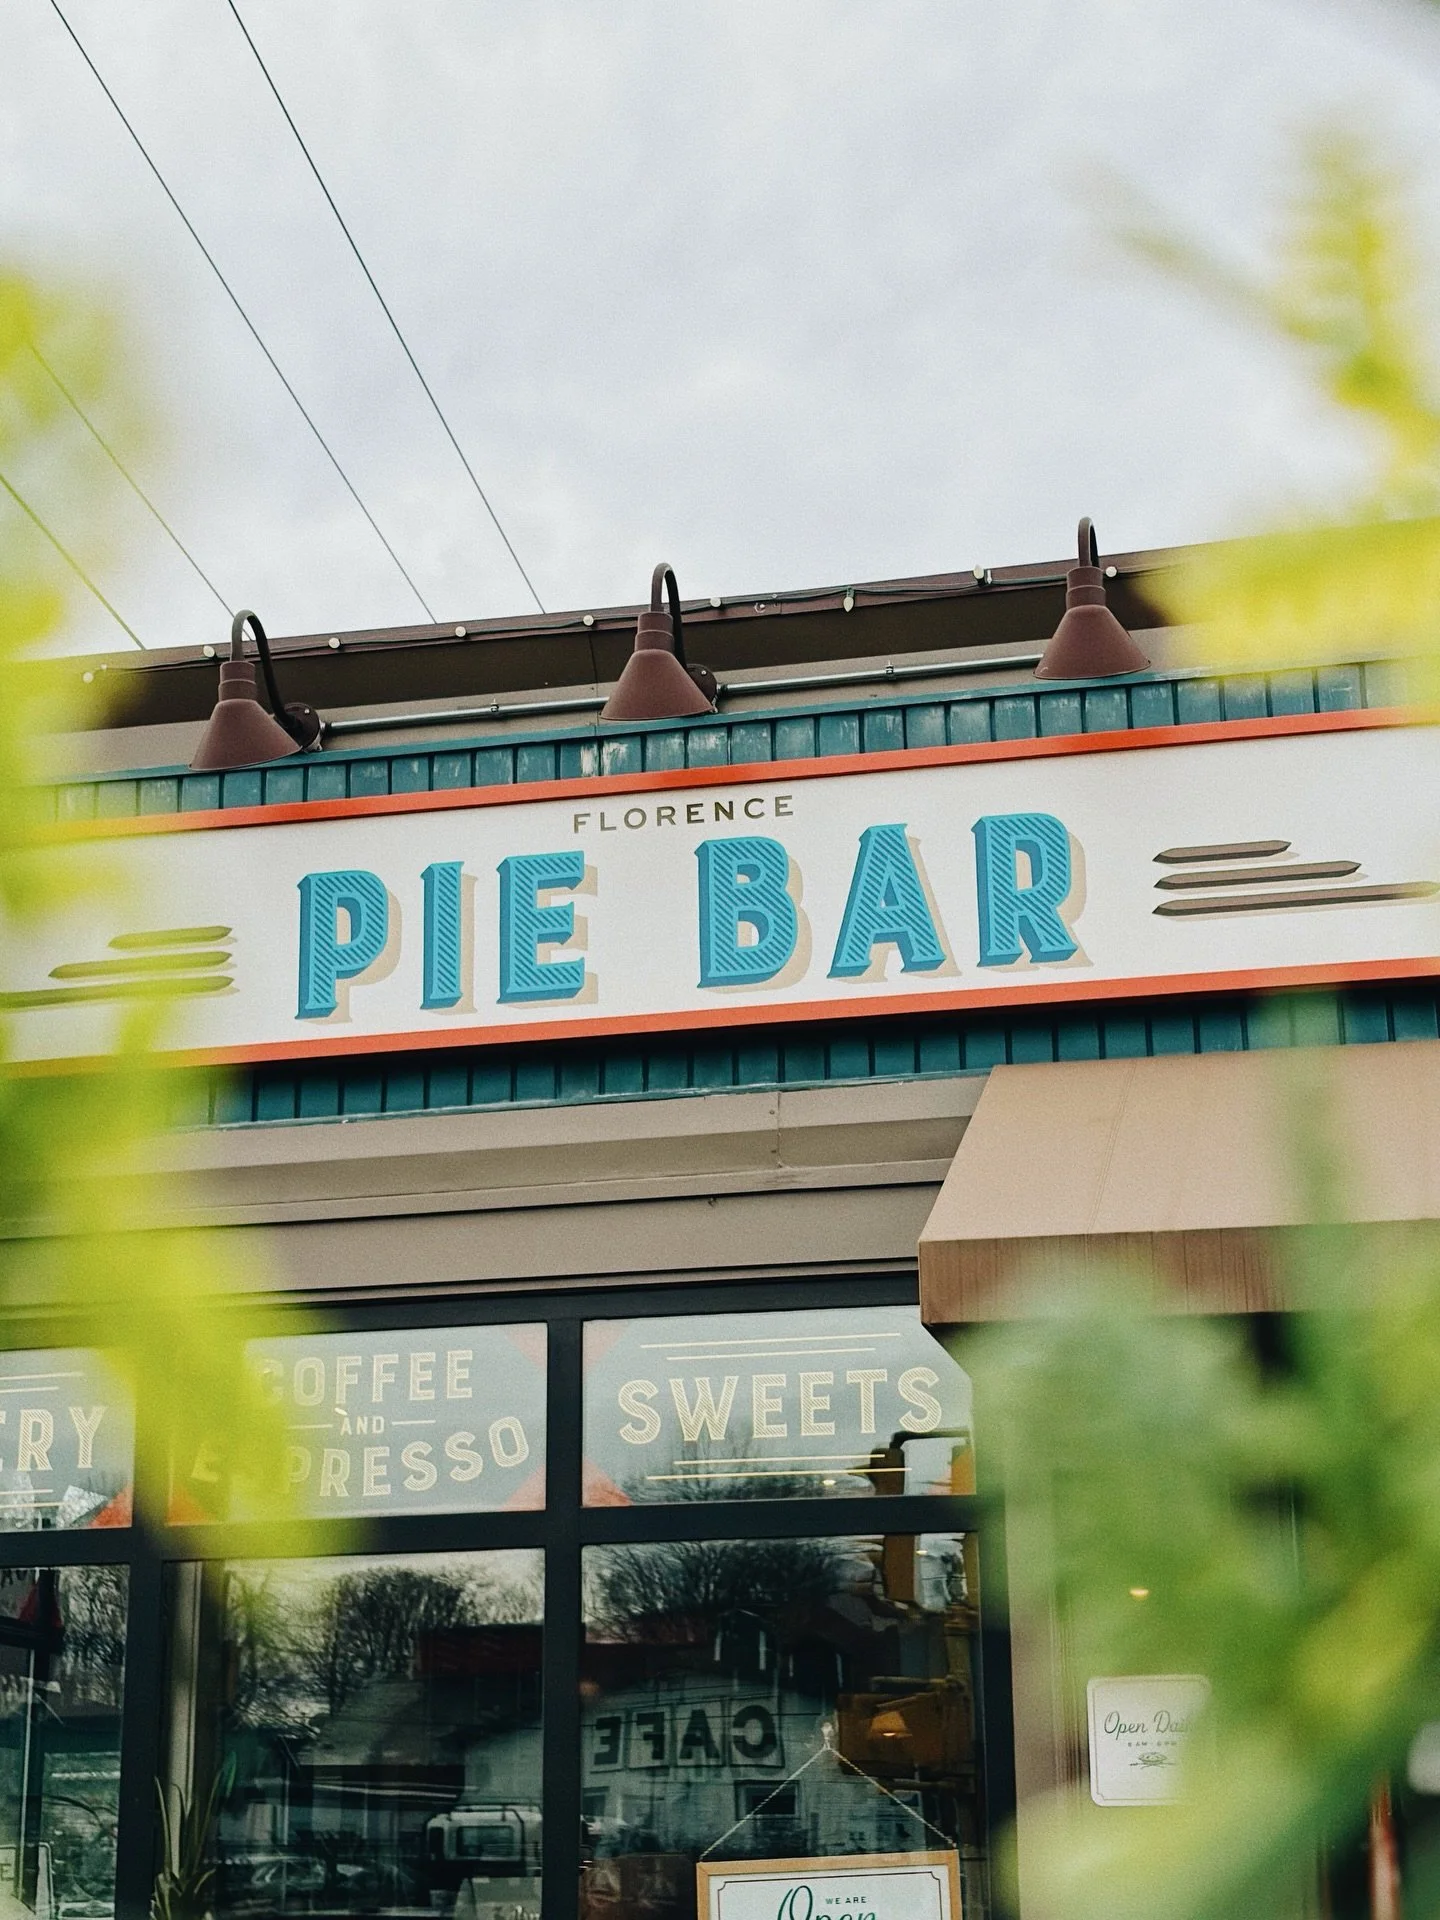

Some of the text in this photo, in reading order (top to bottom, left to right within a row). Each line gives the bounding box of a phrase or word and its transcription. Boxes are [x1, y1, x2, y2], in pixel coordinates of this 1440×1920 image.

[574, 795, 795, 834] FLORENCE
[296, 812, 1084, 1021] PIE BAR
[340, 1415, 386, 1436] AND
[617, 1366, 943, 1444] SWEETS
[0, 1406, 109, 1472] RY
[190, 1416, 530, 1498] EPRESSO
[1104, 1709, 1191, 1741] Open Dai
[845, 1896, 867, 1904] ARE
